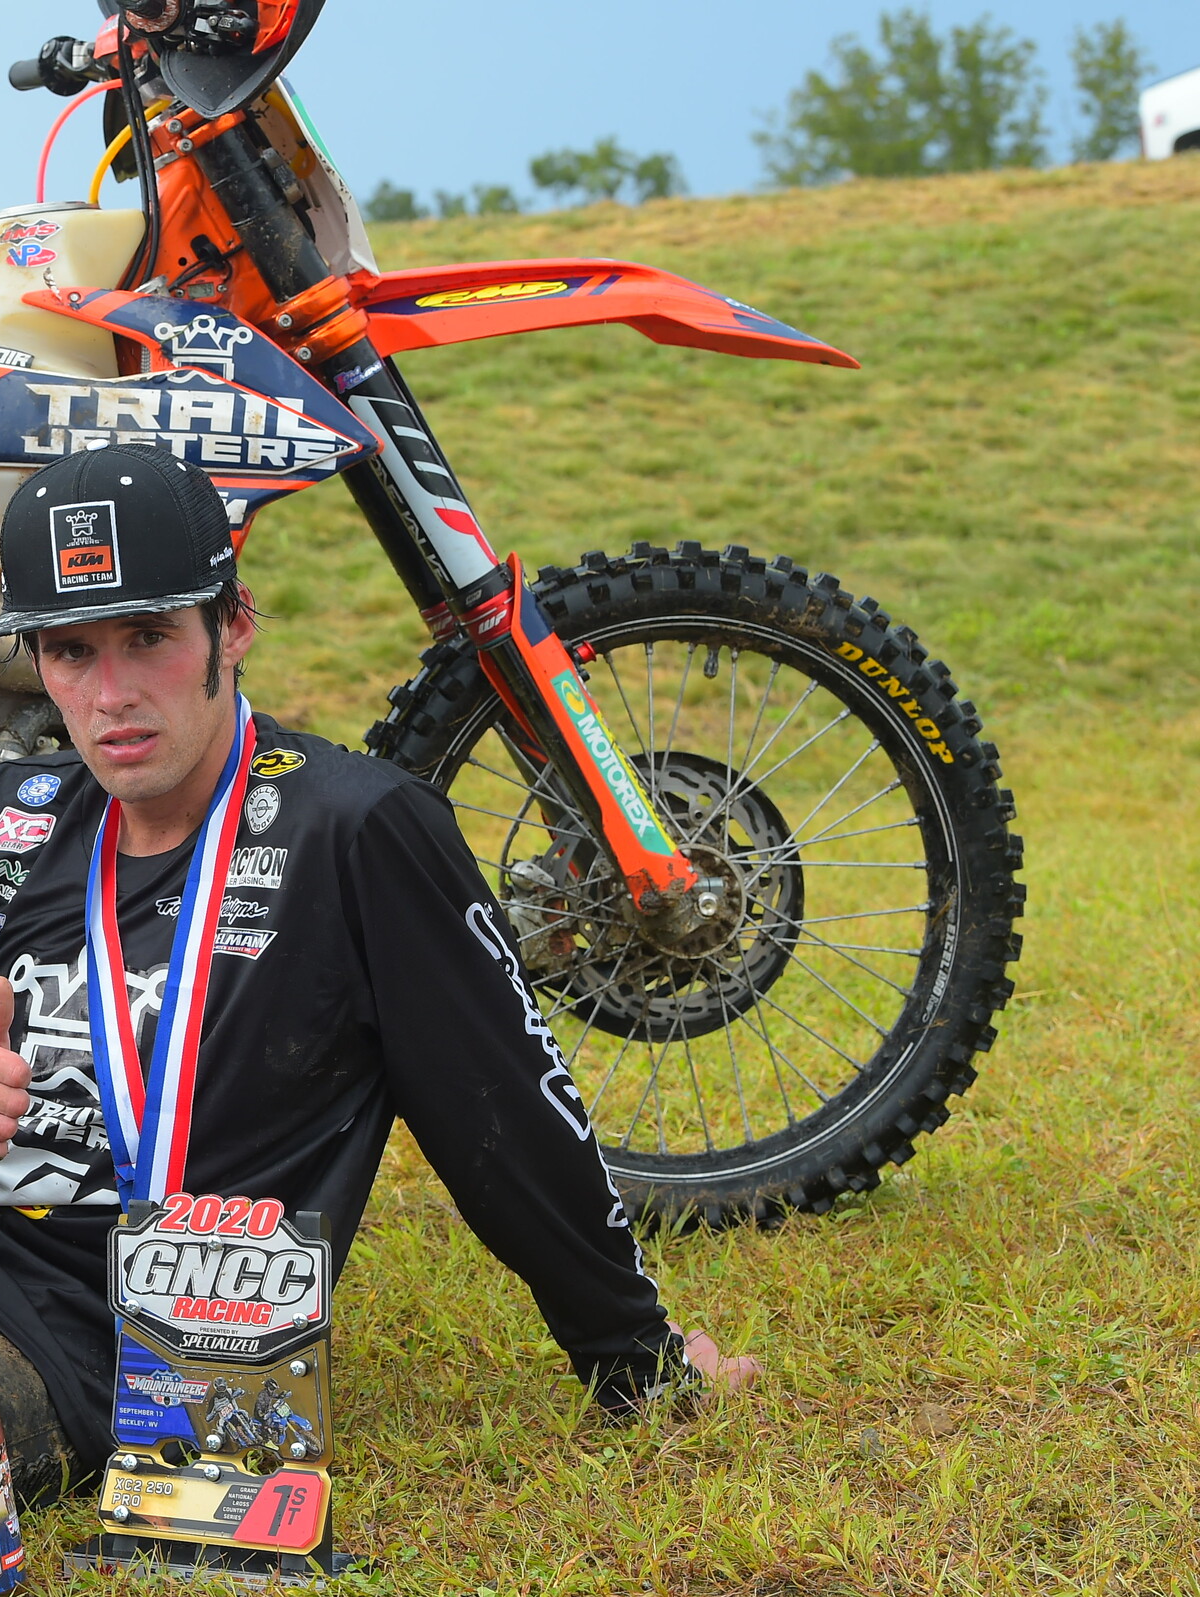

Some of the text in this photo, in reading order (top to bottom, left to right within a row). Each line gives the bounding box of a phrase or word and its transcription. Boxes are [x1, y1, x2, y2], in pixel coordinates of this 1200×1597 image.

[3, 224, 57, 241] IMS
[8, 245, 40, 266] VP
[416, 281, 564, 307] FMF
[25, 383, 336, 441] TRAIL
[67, 552, 104, 568] KTM
[61, 572, 114, 585] RACING TEAM
[836, 641, 955, 765] DUNLOP
[577, 714, 655, 837] MOTOREX
[157, 1194, 283, 1238] 2020
[126, 1241, 314, 1303] GNCC
[171, 1296, 273, 1326] RACING
[200, 1327, 230, 1335] PRESENTED
[179, 1334, 260, 1353] SPECIALIZED
[132, 1377, 203, 1395] MOUNTAINEER
[119, 1407, 154, 1416] SEPTEMBER
[118, 1418, 147, 1428] BECKLEY,
[115, 1477, 173, 1495] XC2 250
[112, 1494, 141, 1507] PRO
[222, 1506, 246, 1514] COUNTRY
